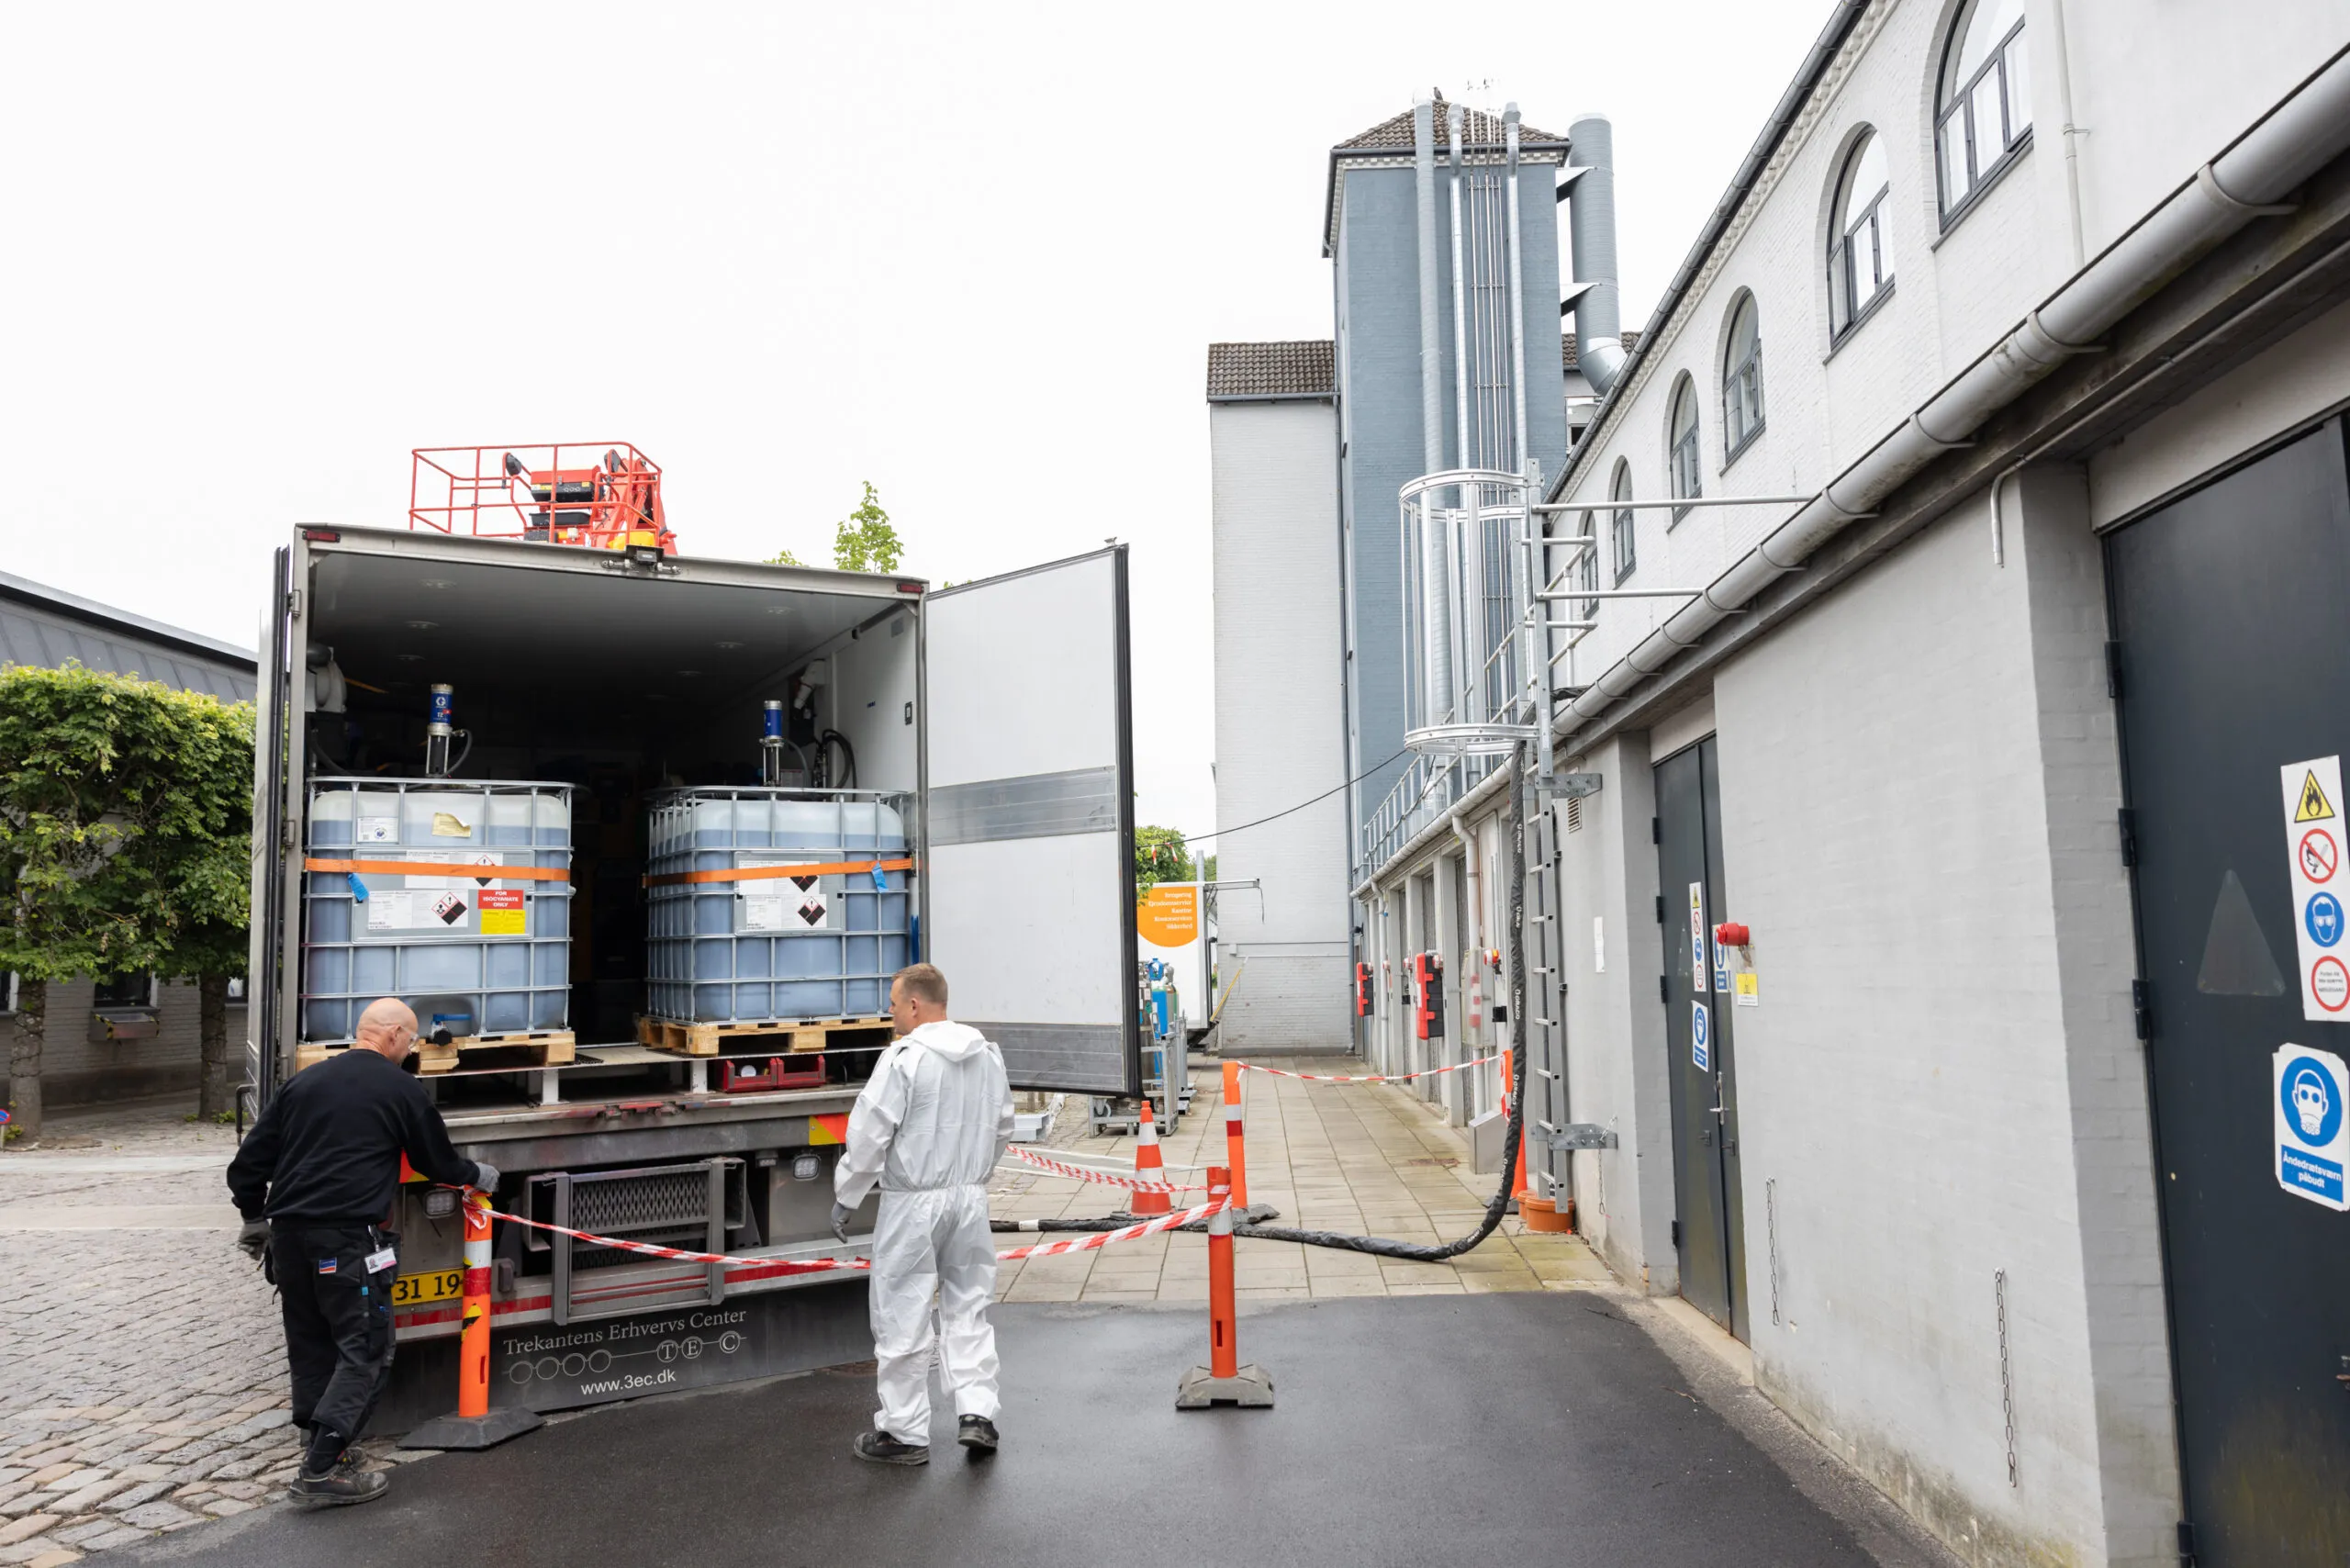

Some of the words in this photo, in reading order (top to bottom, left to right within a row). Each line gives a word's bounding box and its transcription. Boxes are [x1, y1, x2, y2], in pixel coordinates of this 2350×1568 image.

[2283, 1150, 2342, 1182] Åndedrætsværn
[2298, 1172, 2325, 1189] påbudt
[395, 1279, 421, 1301] 31
[434, 1273, 464, 1296] 19
[503, 1328, 603, 1356] Trekantens
[608, 1316, 685, 1341] Erhvervs
[689, 1310, 746, 1329] Center
[580, 1369, 677, 1395] www.3ec.dk
